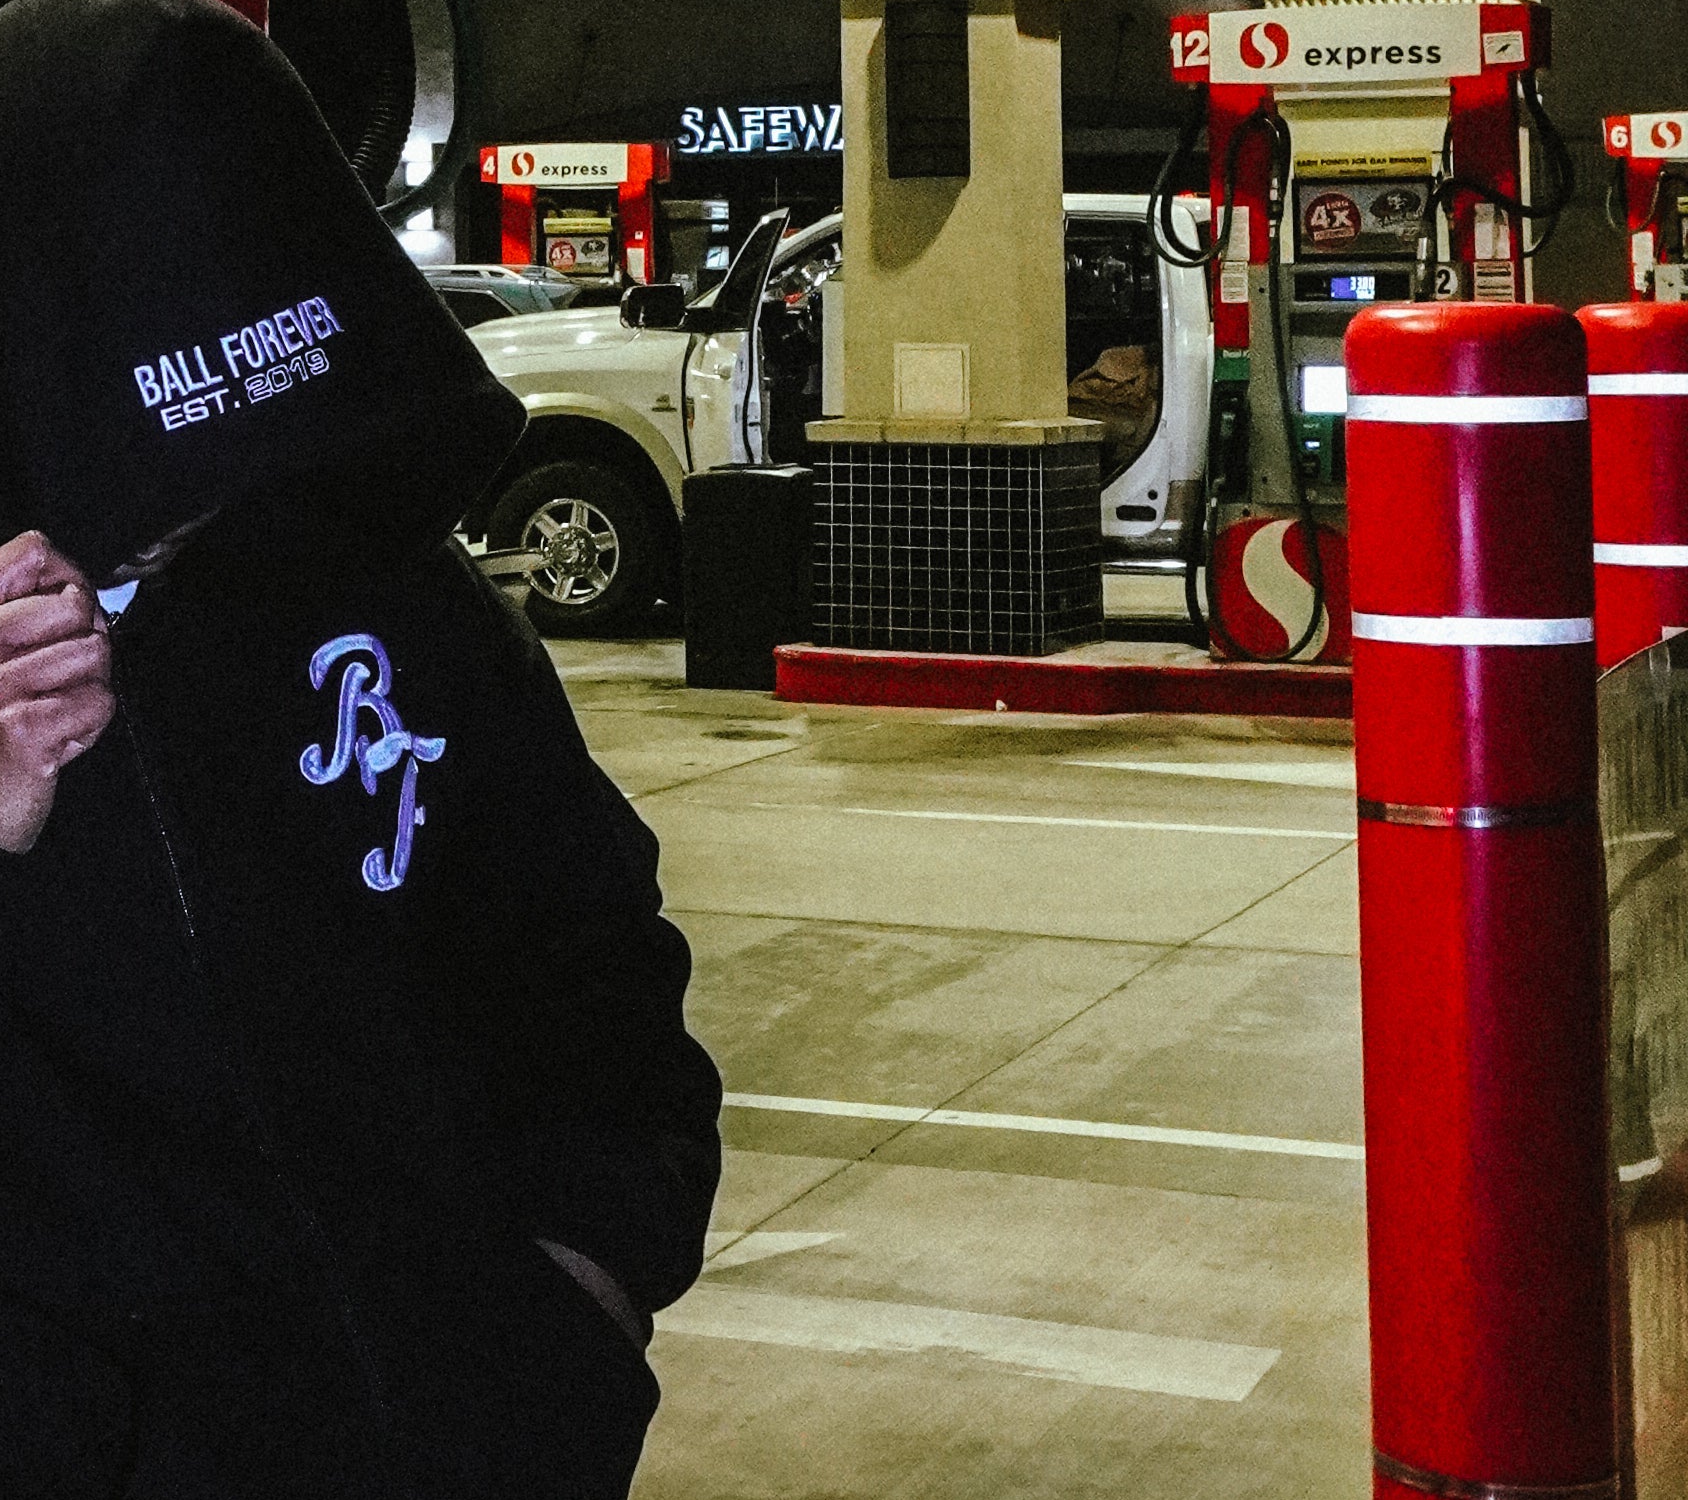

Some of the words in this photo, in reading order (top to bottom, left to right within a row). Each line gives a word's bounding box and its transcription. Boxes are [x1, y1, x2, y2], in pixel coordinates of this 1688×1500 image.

[1170, 29, 1210, 69] 12
[1303, 44, 1443, 70] express
[675, 103, 845, 153] SAFEW
[1609, 124, 1629, 149] 6
[481, 154, 496, 177] 4
[540, 162, 609, 179] express
[133, 344, 224, 409] BALL
[219, 295, 345, 379] FOREVER
[160, 387, 241, 432] EST.
[243, 346, 331, 405] 2019
